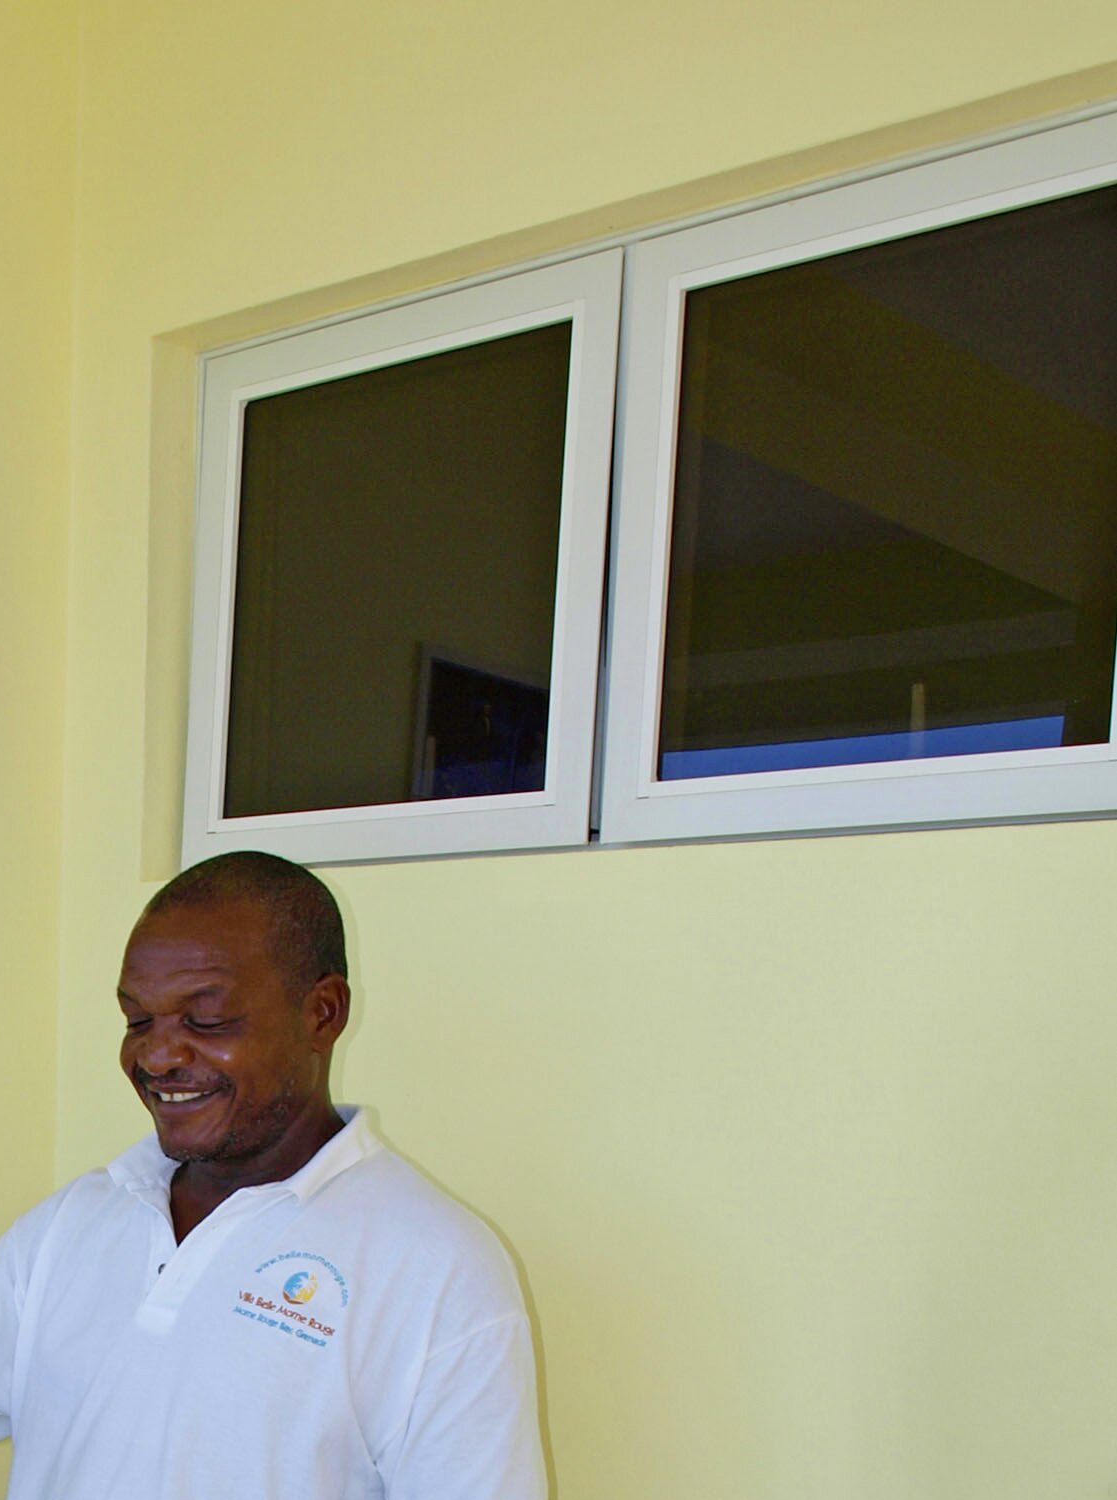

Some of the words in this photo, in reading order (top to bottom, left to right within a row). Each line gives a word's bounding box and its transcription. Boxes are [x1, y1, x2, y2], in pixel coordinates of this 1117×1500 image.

[256, 1297, 277, 1310] Belle
[276, 1305, 307, 1324] Morne
[308, 1317, 336, 1336] Rouge
